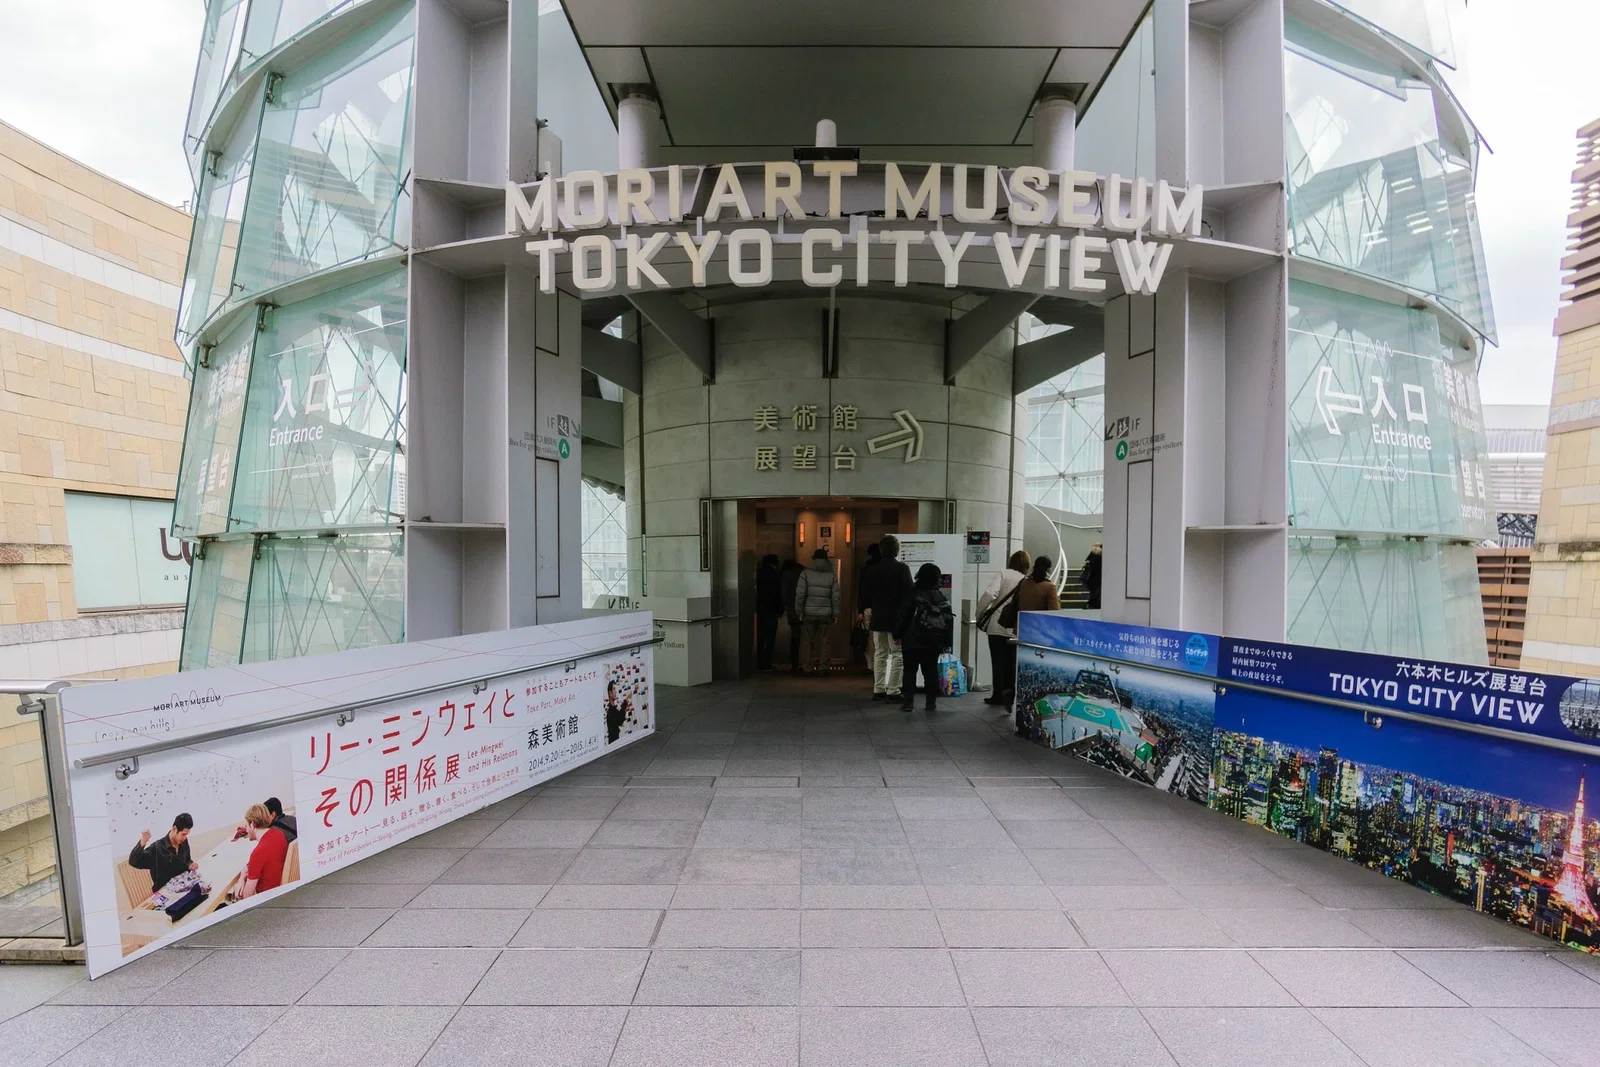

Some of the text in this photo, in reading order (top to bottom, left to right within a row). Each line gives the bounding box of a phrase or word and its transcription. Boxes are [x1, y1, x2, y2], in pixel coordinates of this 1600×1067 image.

[505, 161, 1204, 239] MORI ART MUSEUM
[525, 228, 1174, 296] TOKYO CITY VIEW
[273, 373, 329, 422] 入口
[1371, 376, 1428, 424] 入口
[269, 425, 323, 447] Entrance
[754, 405, 858, 431] 美術館
[1372, 424, 1432, 450] Entrance
[755, 445, 857, 470] 展望台
[1232, 645, 1293, 660] 深夜までゆっくりできる
[1396, 661, 1547, 697] 六本木ヒルズ展望台
[153, 694, 221, 711] MORI ART MUSEUM
[1329, 673, 1545, 725] TOKYO CITY VIEW
[310, 688, 515, 775] リー・ミンウェイと
[468, 740, 504, 759] Lee Mingwei
[527, 714, 579, 751] 森美術館
[468, 749, 518, 772] and His Relations
[315, 753, 461, 828] その関係展
